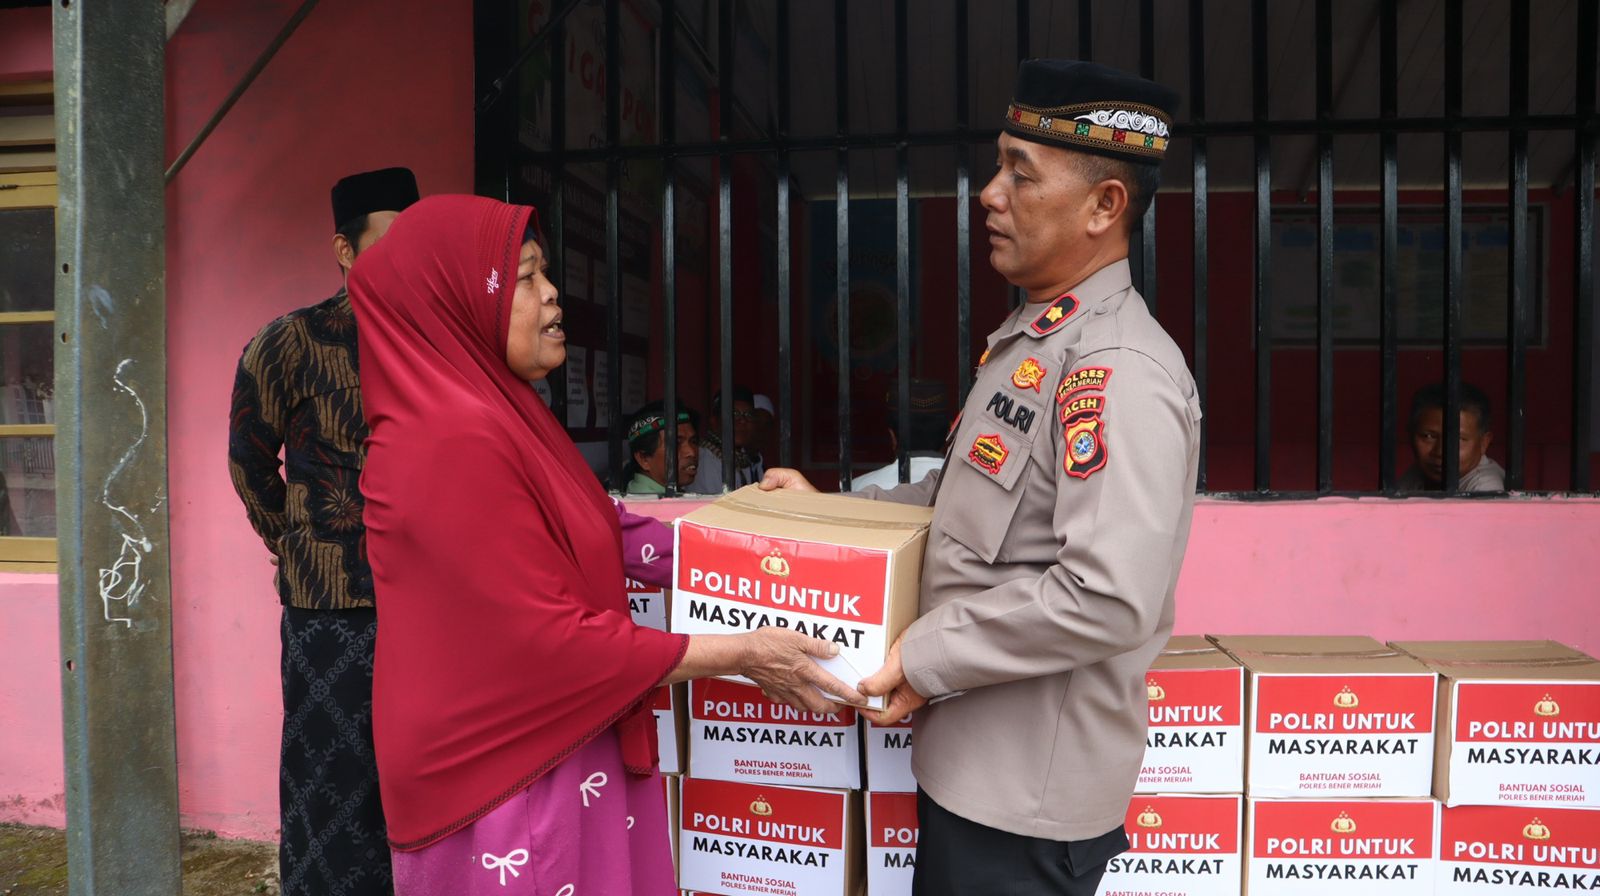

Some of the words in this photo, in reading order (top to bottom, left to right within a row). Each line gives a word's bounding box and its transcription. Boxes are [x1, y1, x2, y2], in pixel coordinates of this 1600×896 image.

[1058, 369, 1105, 393] POLRES
[1077, 377, 1103, 388] MERIAH
[986, 391, 1036, 434] POLRI
[1064, 398, 1097, 417] ACEH
[690, 568, 761, 600] POLRI
[770, 583, 861, 617] UNTUK
[704, 700, 763, 719] POLRI
[1149, 705, 1224, 723] UNTUK
[1269, 712, 1334, 730] POLRI
[1342, 712, 1415, 730] UNTUK
[1469, 721, 1534, 739] POLRI
[703, 725, 845, 747] MASYARAKAT
[1268, 739, 1419, 755] MASYARAKAT
[734, 759, 777, 770] BANTUAN
[779, 761, 812, 771] SOSIAL
[734, 768, 761, 776] POLRES
[762, 769, 785, 777] BENER
[786, 770, 813, 779] MERIAH
[1158, 766, 1192, 775] SOSIAL
[1164, 776, 1193, 784] MERIAH
[1299, 772, 1346, 781] BANTUAN
[1347, 772, 1382, 781] SOSIAL
[1499, 783, 1547, 792] BANTUAN
[1549, 784, 1585, 793] SOSIAL
[1498, 793, 1528, 801] POLRES
[1555, 794, 1585, 802] MERIAH
[693, 812, 750, 835] POLRI
[758, 821, 826, 844] UNTUK
[1147, 833, 1220, 850] UNTUK
[1266, 838, 1331, 855] POLRI
[1340, 838, 1415, 855] UNTUK
[1454, 841, 1523, 859] POLRI
[692, 836, 830, 868] MASYARAKAT
[721, 871, 764, 886] BANTUAN
[764, 877, 797, 889] SOSIAL
[1266, 863, 1419, 881] MASYARAKAT
[720, 880, 746, 890] POLRES
[747, 884, 769, 893] BENER
[769, 887, 797, 896] MERIAH
